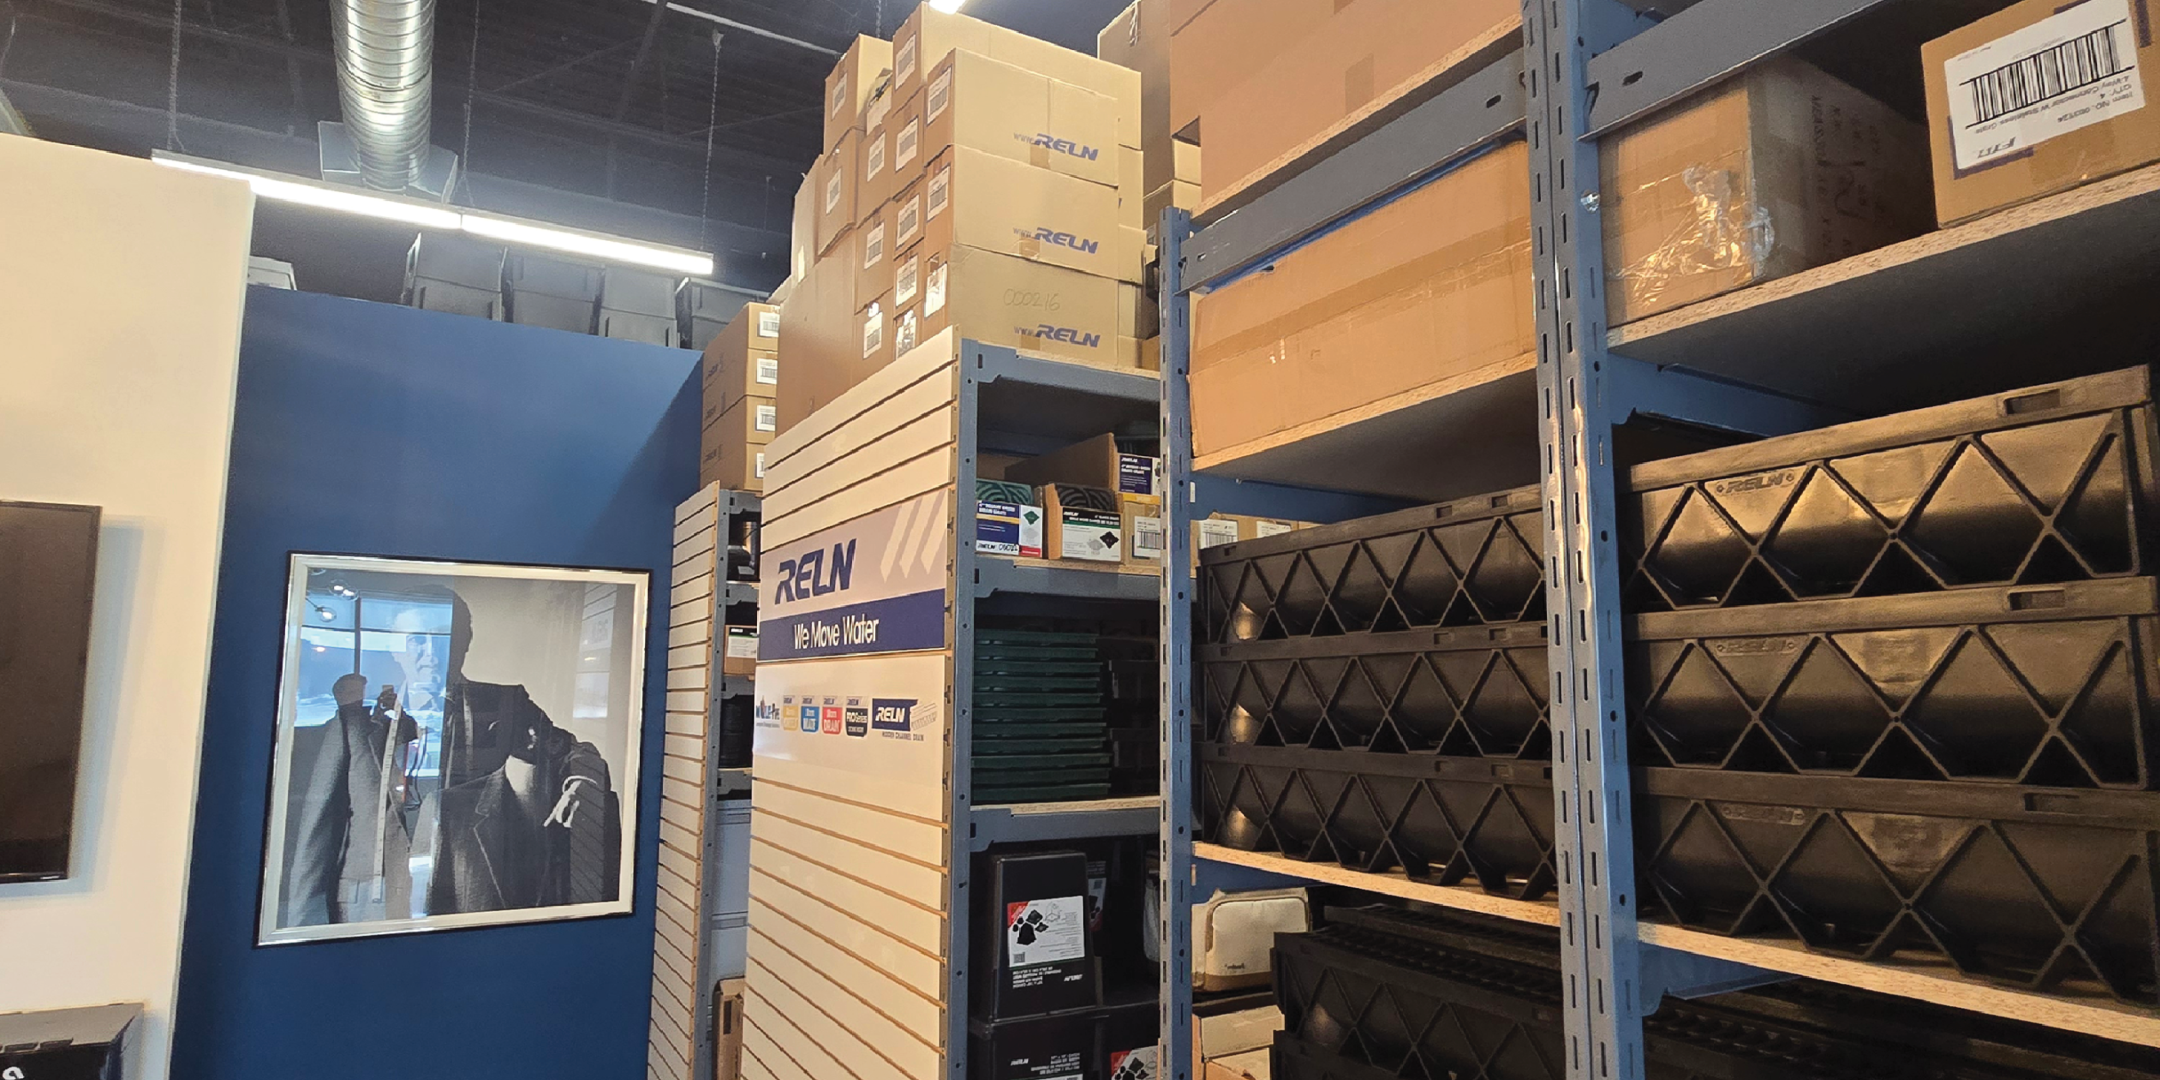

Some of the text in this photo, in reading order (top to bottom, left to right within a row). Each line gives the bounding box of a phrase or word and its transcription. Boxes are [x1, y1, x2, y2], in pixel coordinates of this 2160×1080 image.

[2050, 87, 2099, 108] Connector
[1726, 473, 1784, 493] RELN
[774, 538, 857, 605] RELN
[793, 614, 879, 650] We Move Water
[875, 707, 905, 723] RELN
